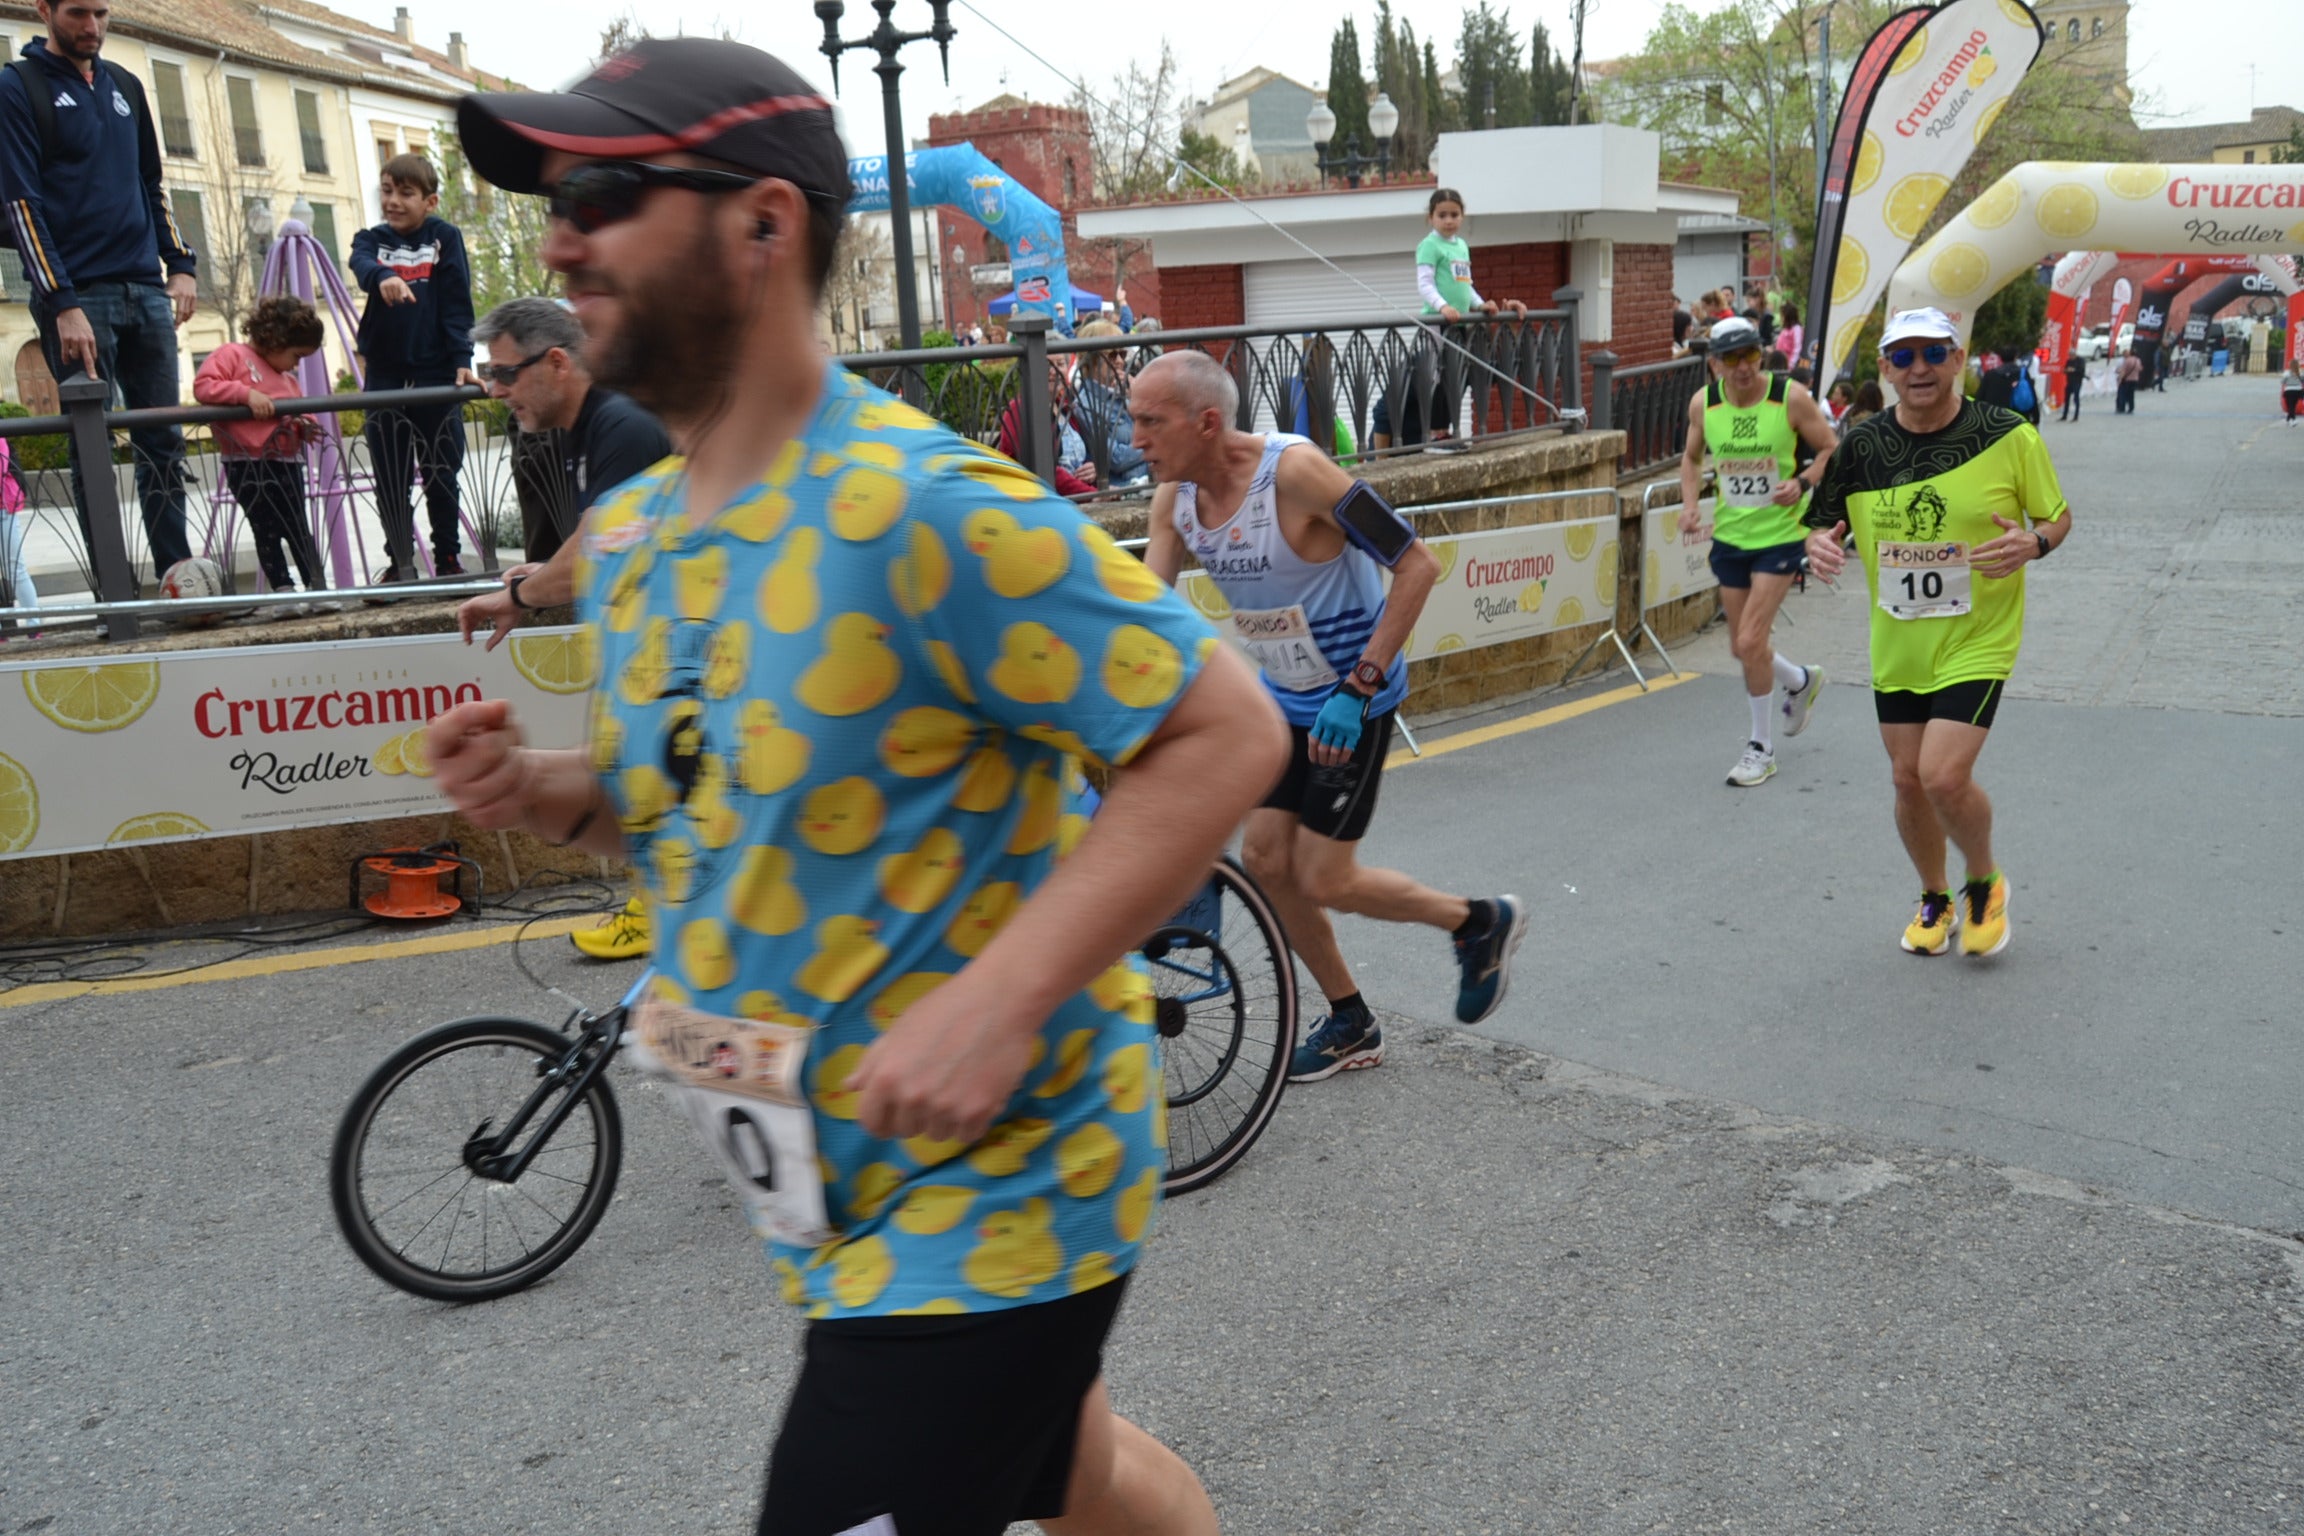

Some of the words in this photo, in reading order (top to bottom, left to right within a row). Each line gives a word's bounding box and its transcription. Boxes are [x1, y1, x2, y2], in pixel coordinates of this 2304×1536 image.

[1896, 30, 1987, 138] Cruzcampo
[1925, 88, 1974, 138] Radler
[2168, 176, 2304, 208] Cruzca
[2184, 217, 2284, 246] Radler
[1719, 442, 1773, 454] Alhambra
[1728, 476, 1769, 495] 323
[1876, 488, 1896, 507] XI
[1466, 554, 1554, 589] Cruzcampo
[1901, 571, 1943, 600] 10
[1474, 596, 1517, 623] Radler
[272, 674, 337, 688] DESDE
[358, 669, 408, 683] 1904
[194, 681, 483, 738] Cruzcampo
[230, 749, 372, 794] Radler
